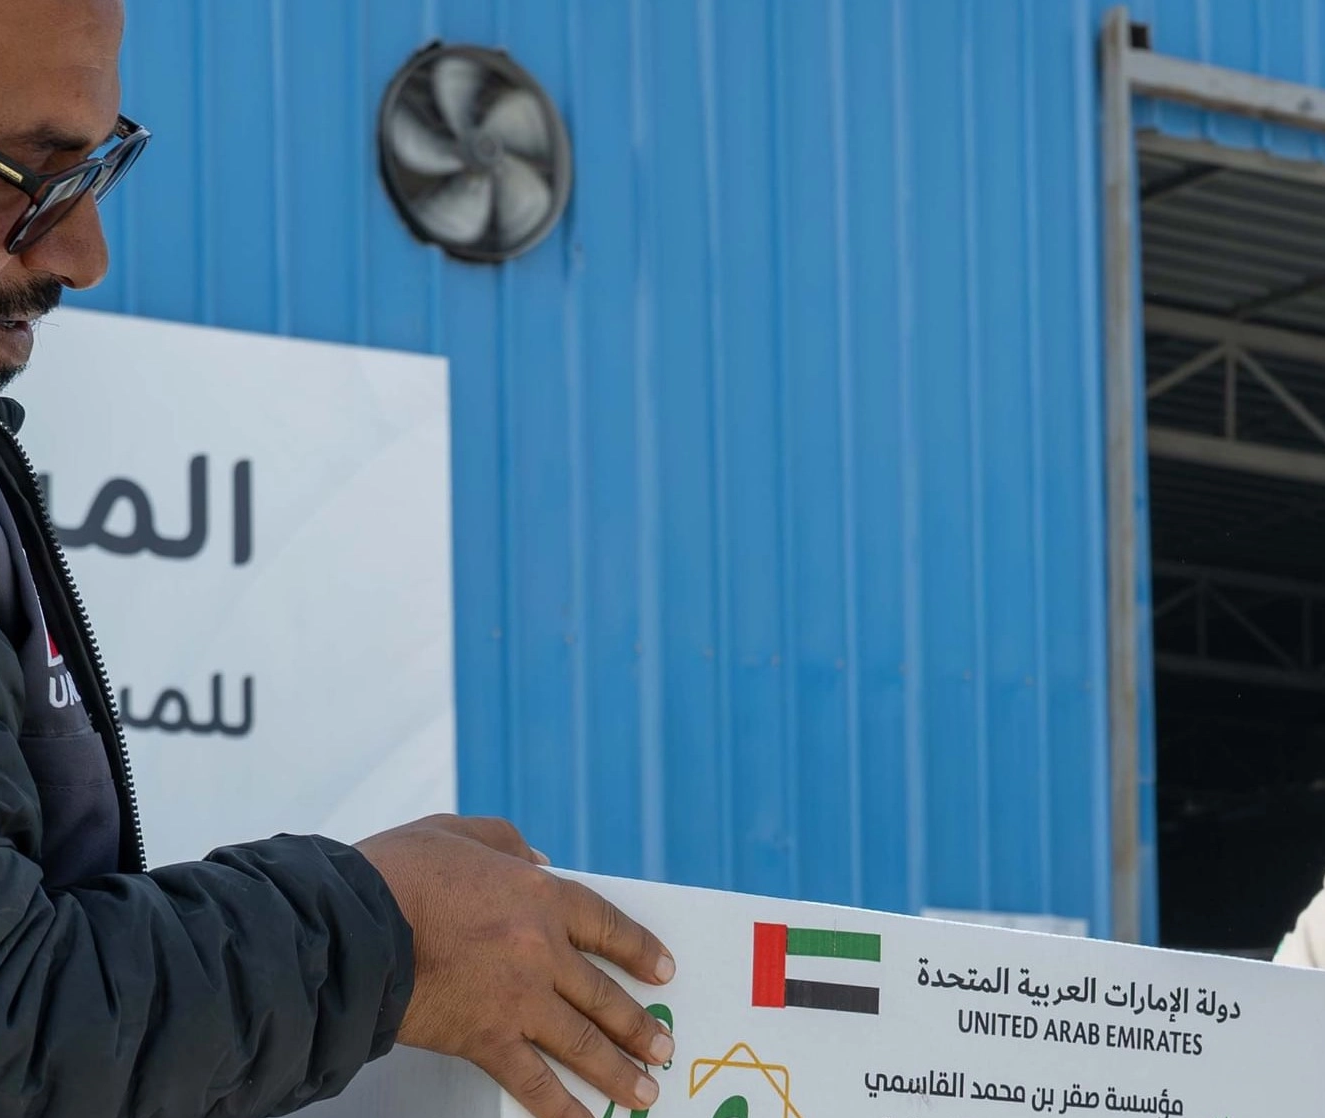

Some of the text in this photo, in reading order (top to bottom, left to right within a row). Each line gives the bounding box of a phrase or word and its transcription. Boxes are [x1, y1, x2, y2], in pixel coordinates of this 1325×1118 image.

[917, 958, 1241, 1023] دولة الإمارات العربية المتحدة
[957, 1009, 1202, 1055] UNITED ARAB EMIRATES
[863, 1070, 964, 1099] القاسمي
[970, 1082, 1026, 1104] محمد
[1058, 1084, 1100, 1115] صقر
[1031, 1088, 1054, 1113] بن
